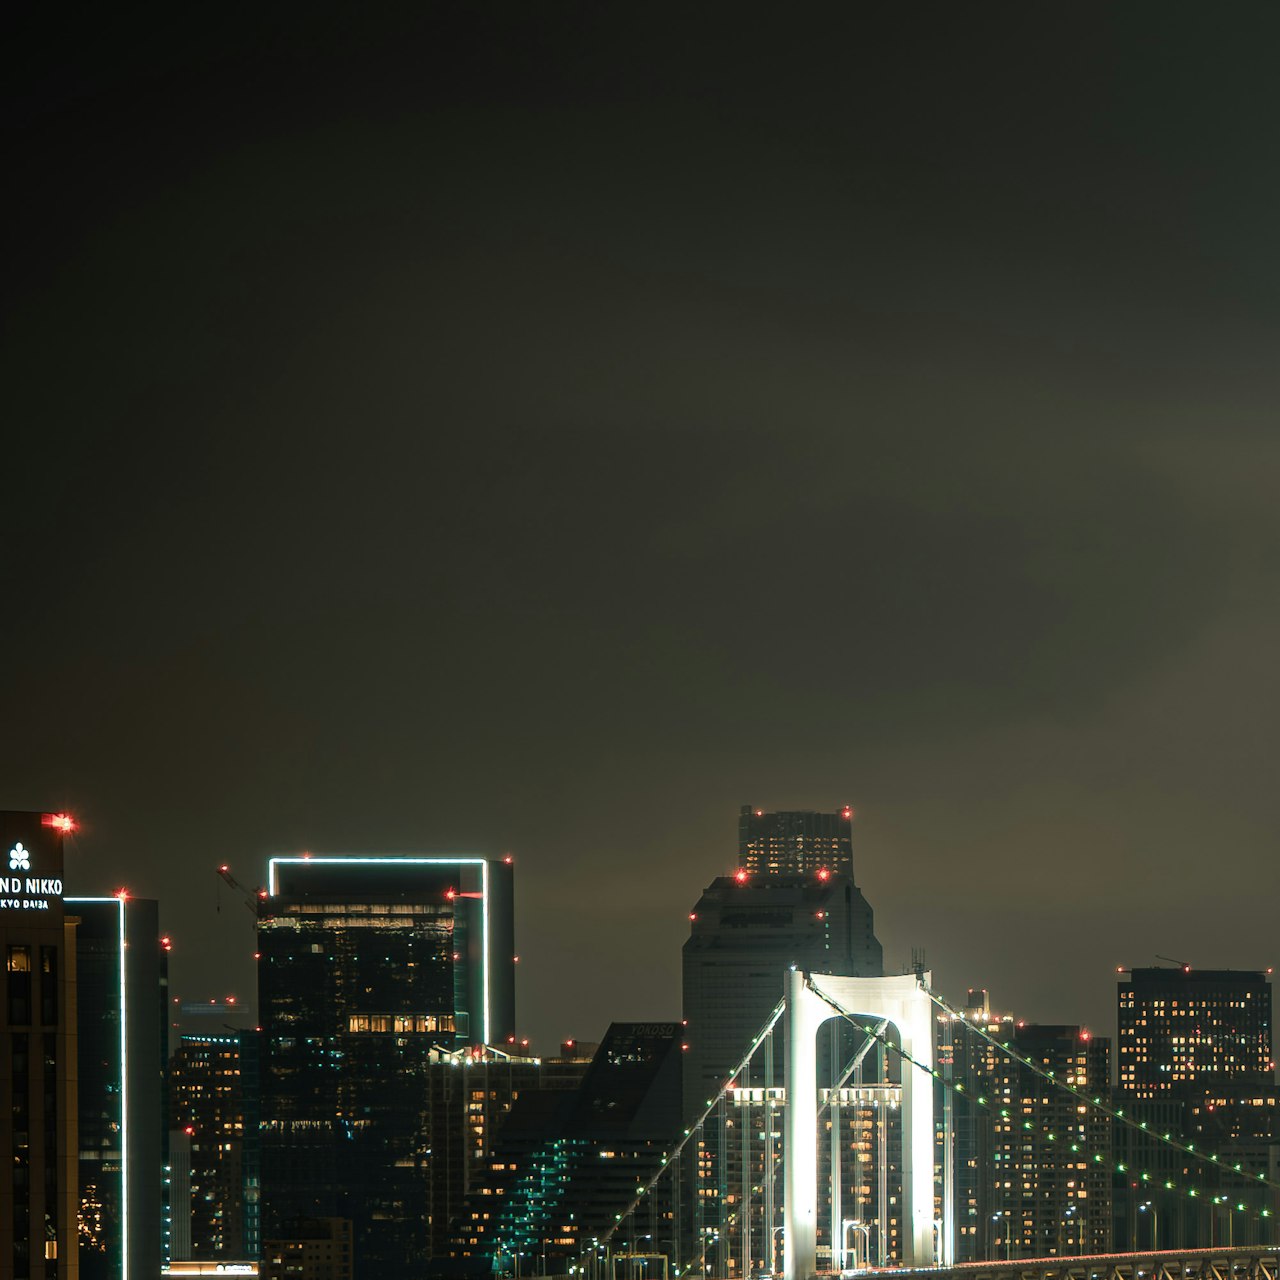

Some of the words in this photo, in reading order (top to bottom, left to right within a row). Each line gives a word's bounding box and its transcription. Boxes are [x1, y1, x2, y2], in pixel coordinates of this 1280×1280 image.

[26, 878, 63, 895] NIKKO
[23, 900, 49, 909] DAIBA
[631, 1024, 674, 1036] YOKOSO
